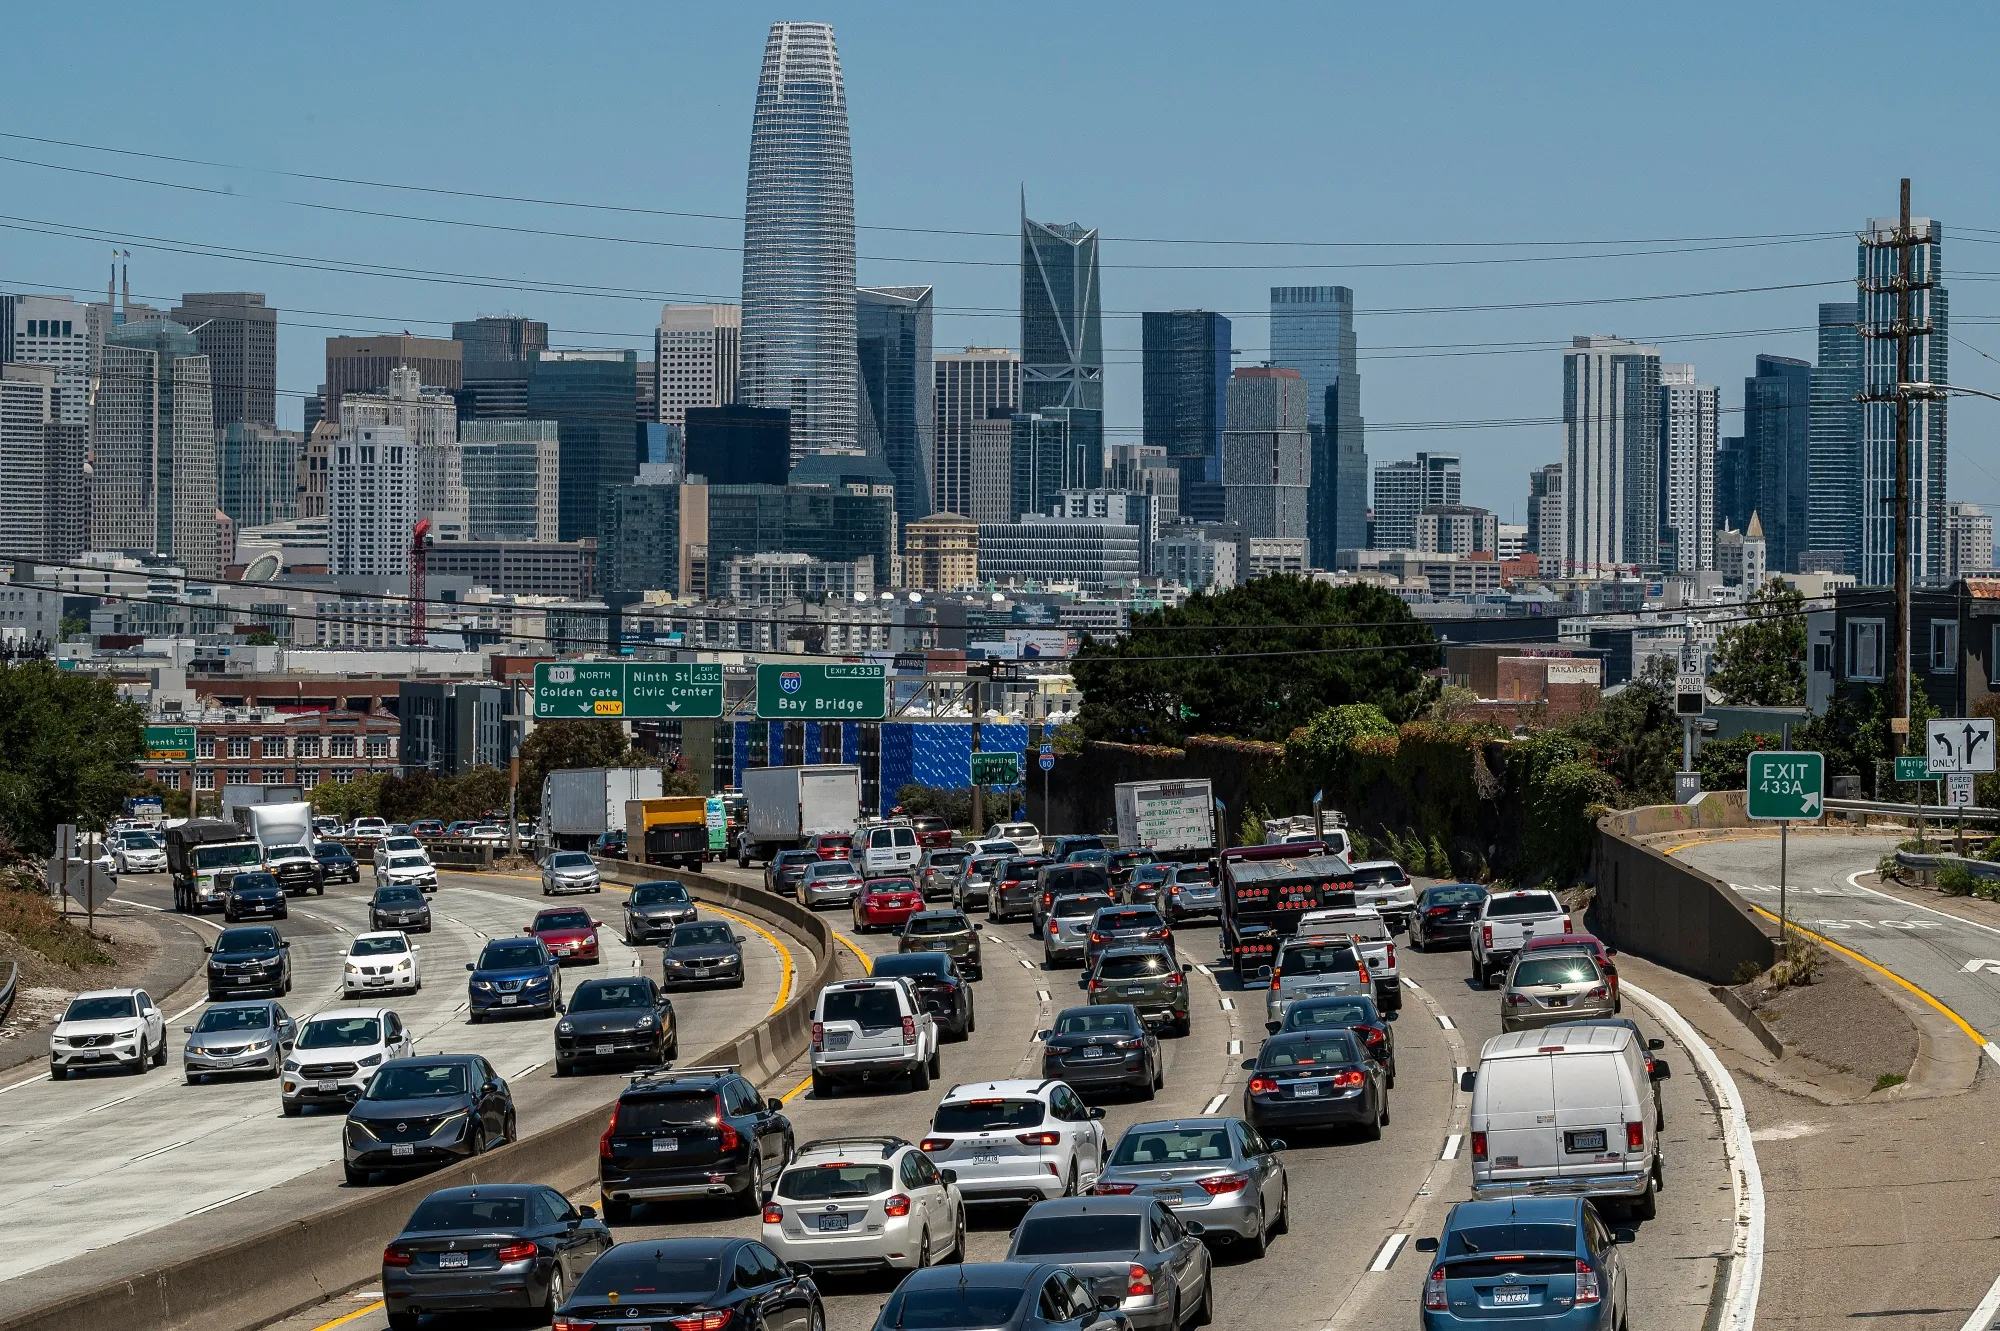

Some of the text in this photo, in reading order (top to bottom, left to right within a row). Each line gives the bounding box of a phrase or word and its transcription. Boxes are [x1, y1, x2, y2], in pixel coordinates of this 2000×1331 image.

[850, 667, 881, 676] 433B
[1681, 661, 1697, 673] 15
[554, 671, 611, 680] 101 NORTH
[633, 671, 689, 682] Ninth St
[694, 673, 719, 681] 433C
[783, 679, 798, 690] 80
[1679, 677, 1701, 685] YOUR
[540, 687, 618, 697] Golden Gate
[633, 687, 714, 697] Civic Center
[540, 702, 621, 713] Br ONLY
[778, 698, 864, 713] Bay Bridge
[1932, 759, 1957, 768] ONLY
[1763, 763, 1809, 779] EXIT
[1905, 769, 1915, 777] St
[1760, 780, 1804, 795] 433A
[1952, 790, 1969, 803] 15
[1815, 919, 1943, 929] STOP
